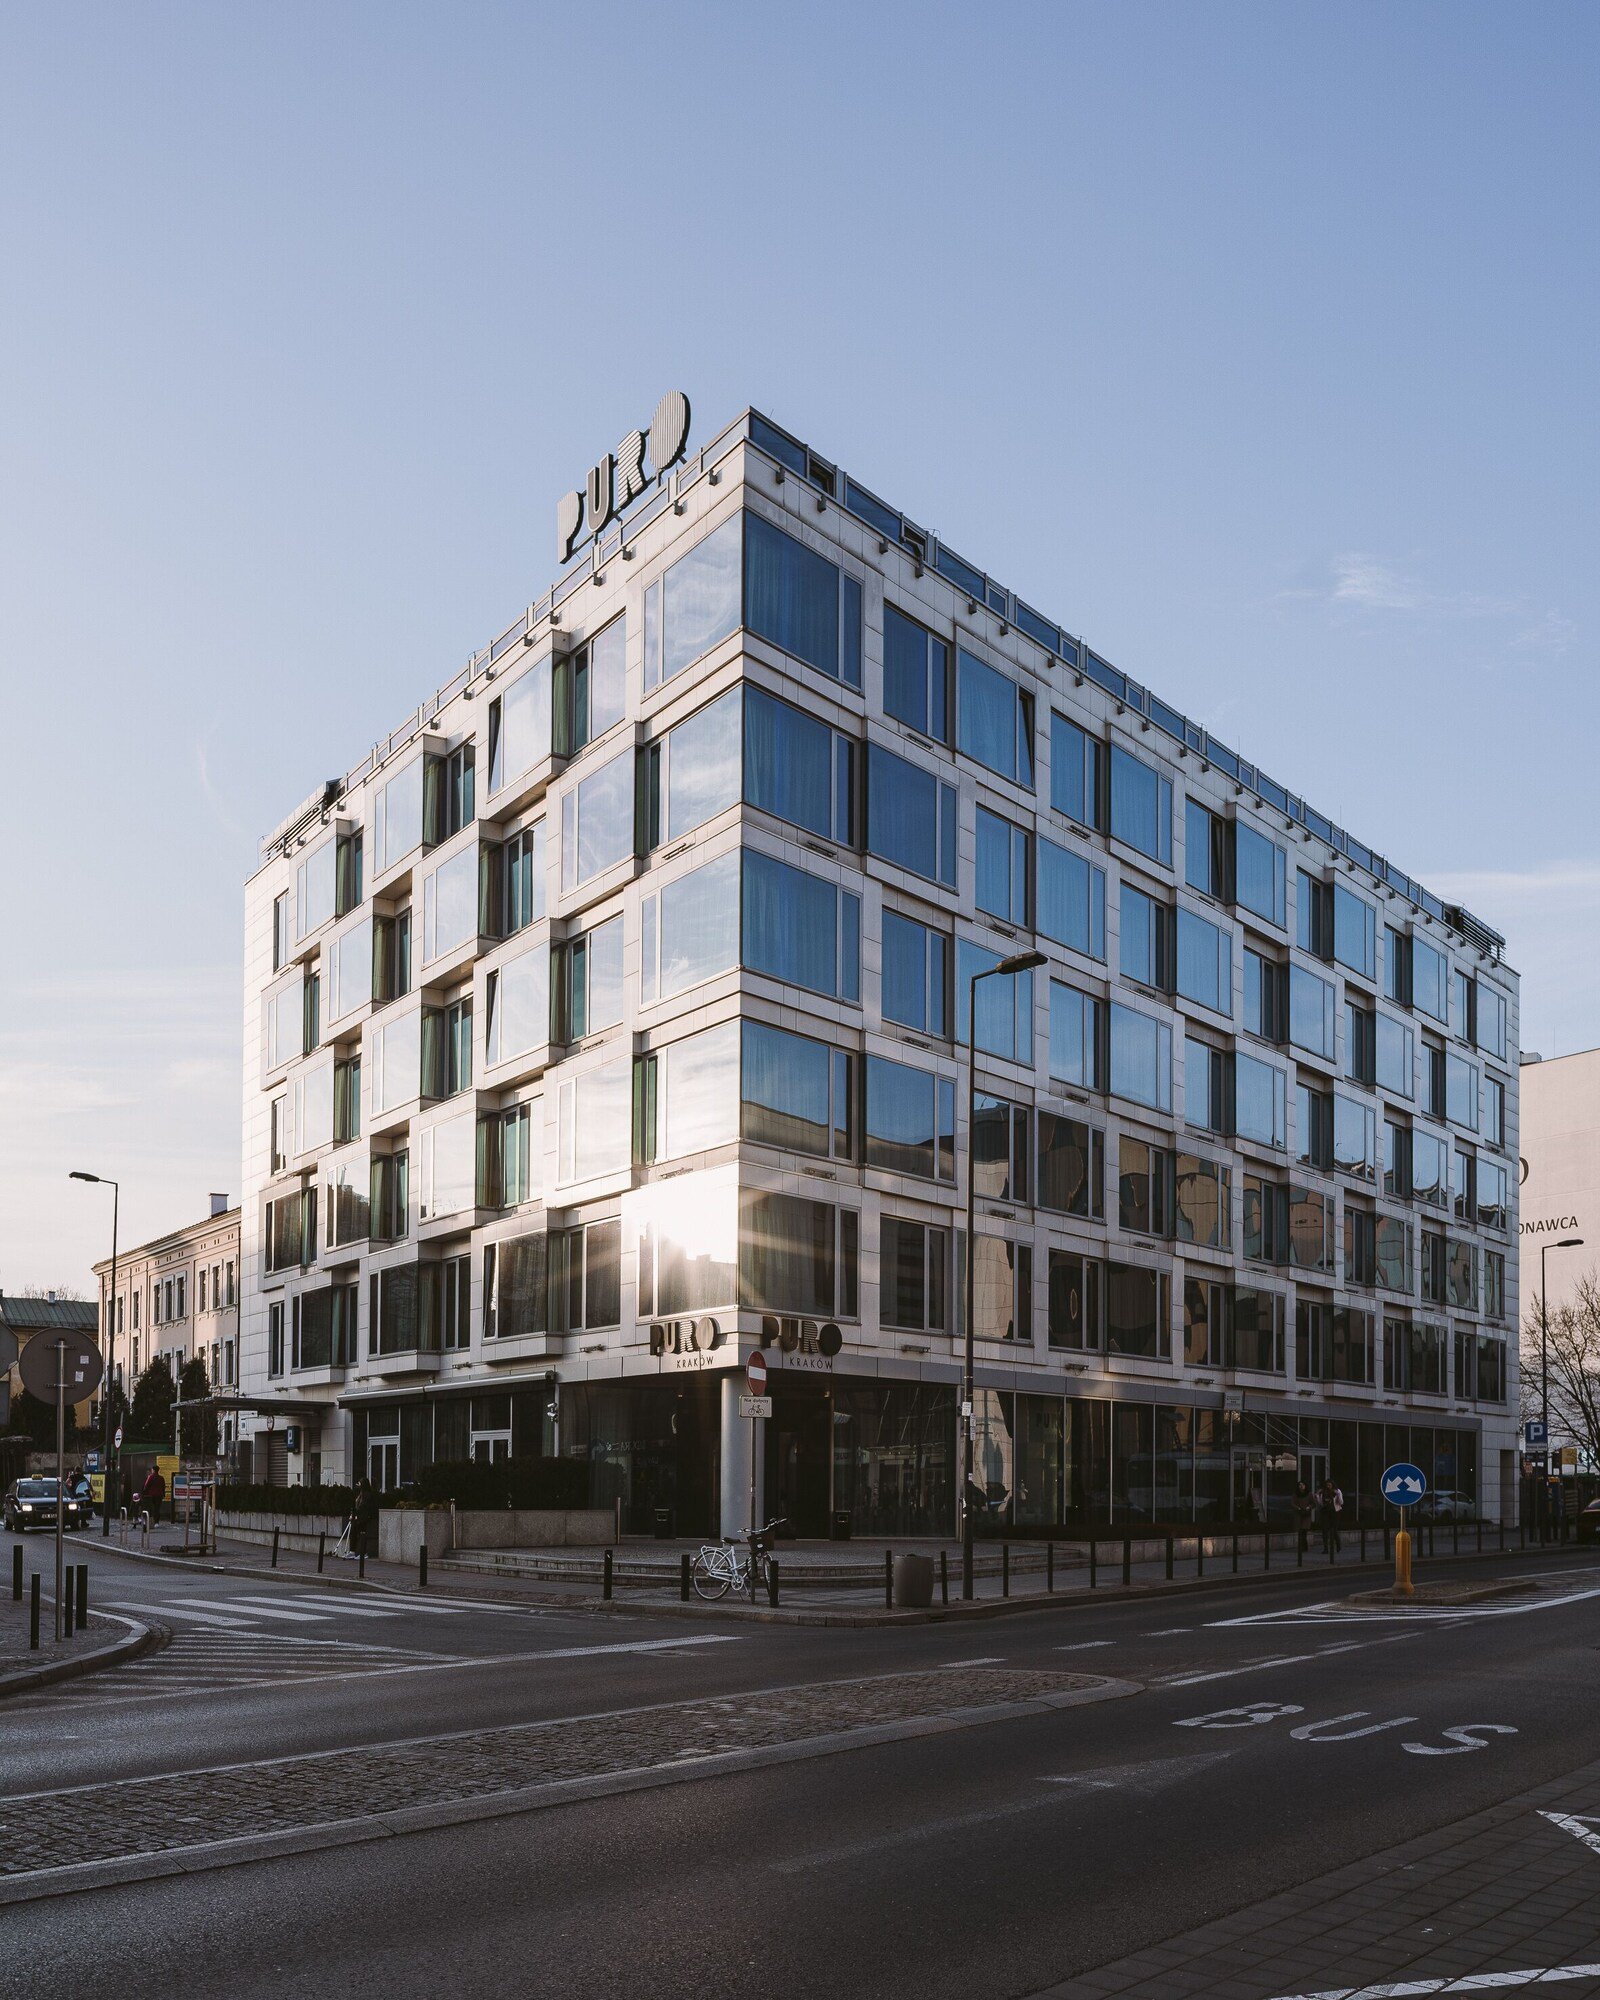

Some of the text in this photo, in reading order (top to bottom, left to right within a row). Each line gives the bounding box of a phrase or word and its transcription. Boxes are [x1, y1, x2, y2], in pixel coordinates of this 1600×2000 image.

[558, 390, 691, 565] PURO
[650, 1317, 717, 1356] PURO
[762, 1315, 842, 1356] PURO
[676, 1356, 714, 1368] KRAKÓW
[789, 1357, 832, 1369] KRAKÓW
[1530, 1425, 1543, 1440] P
[1172, 1702, 1518, 1755] BUS
